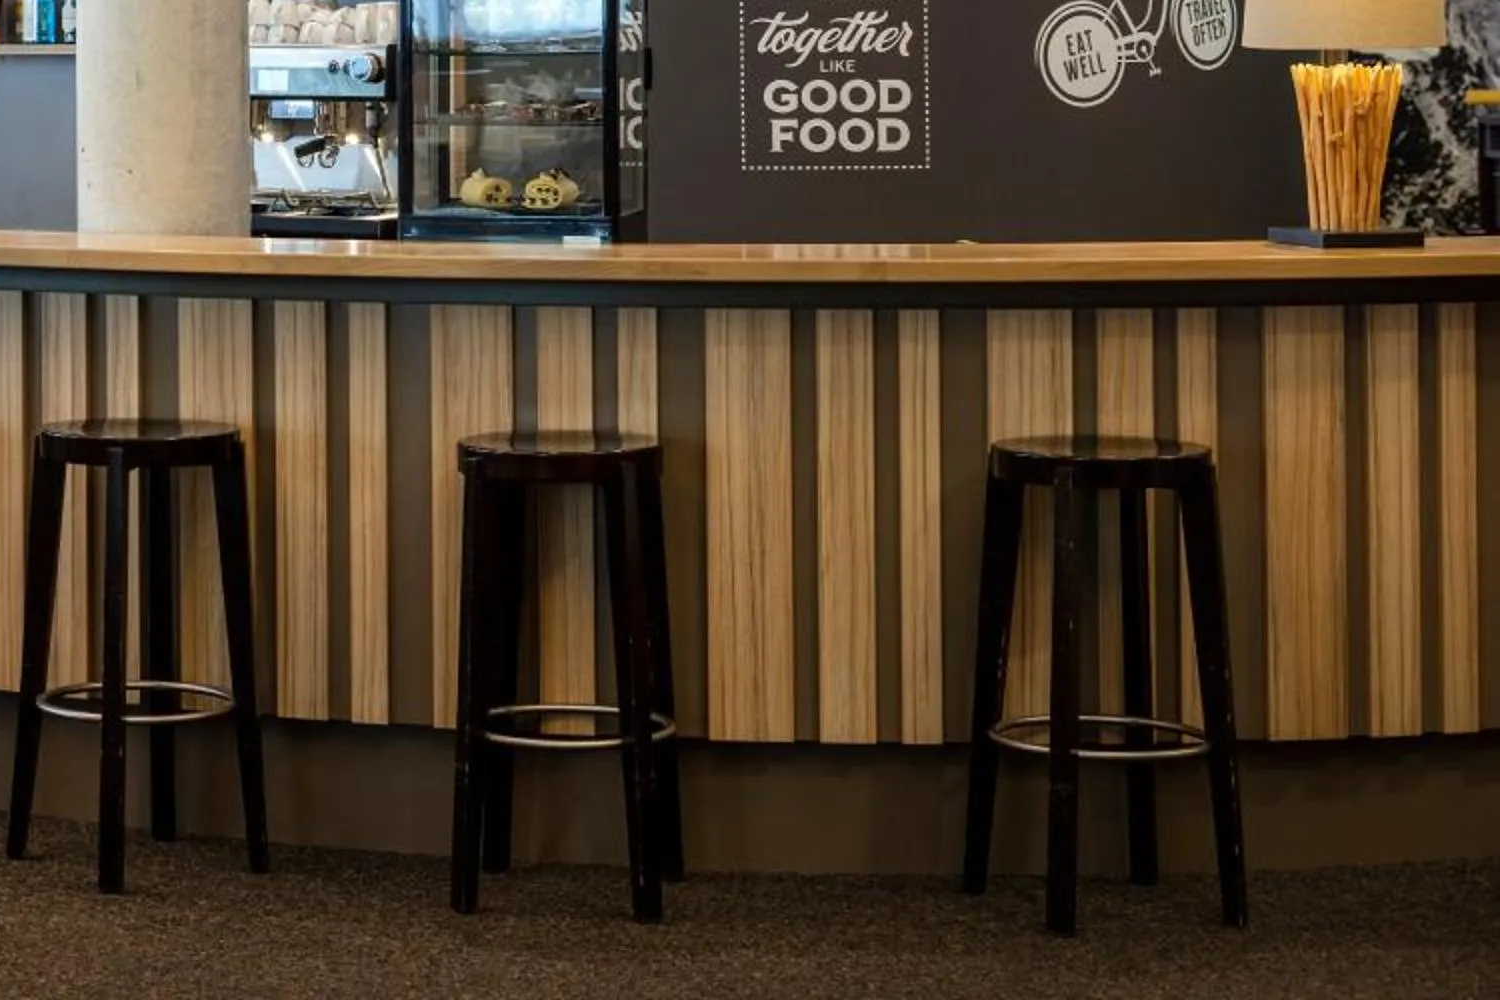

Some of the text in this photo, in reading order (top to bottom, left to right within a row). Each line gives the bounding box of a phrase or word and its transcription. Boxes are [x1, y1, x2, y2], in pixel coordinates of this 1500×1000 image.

[750, 10, 913, 68] together
[1065, 29, 1093, 57] EAT
[1192, 18, 1227, 48] OFTEN
[819, 59, 856, 73] LIKE
[1063, 53, 1107, 83] WELL
[763, 79, 912, 114] GOOD
[770, 118, 911, 153] FOOD
